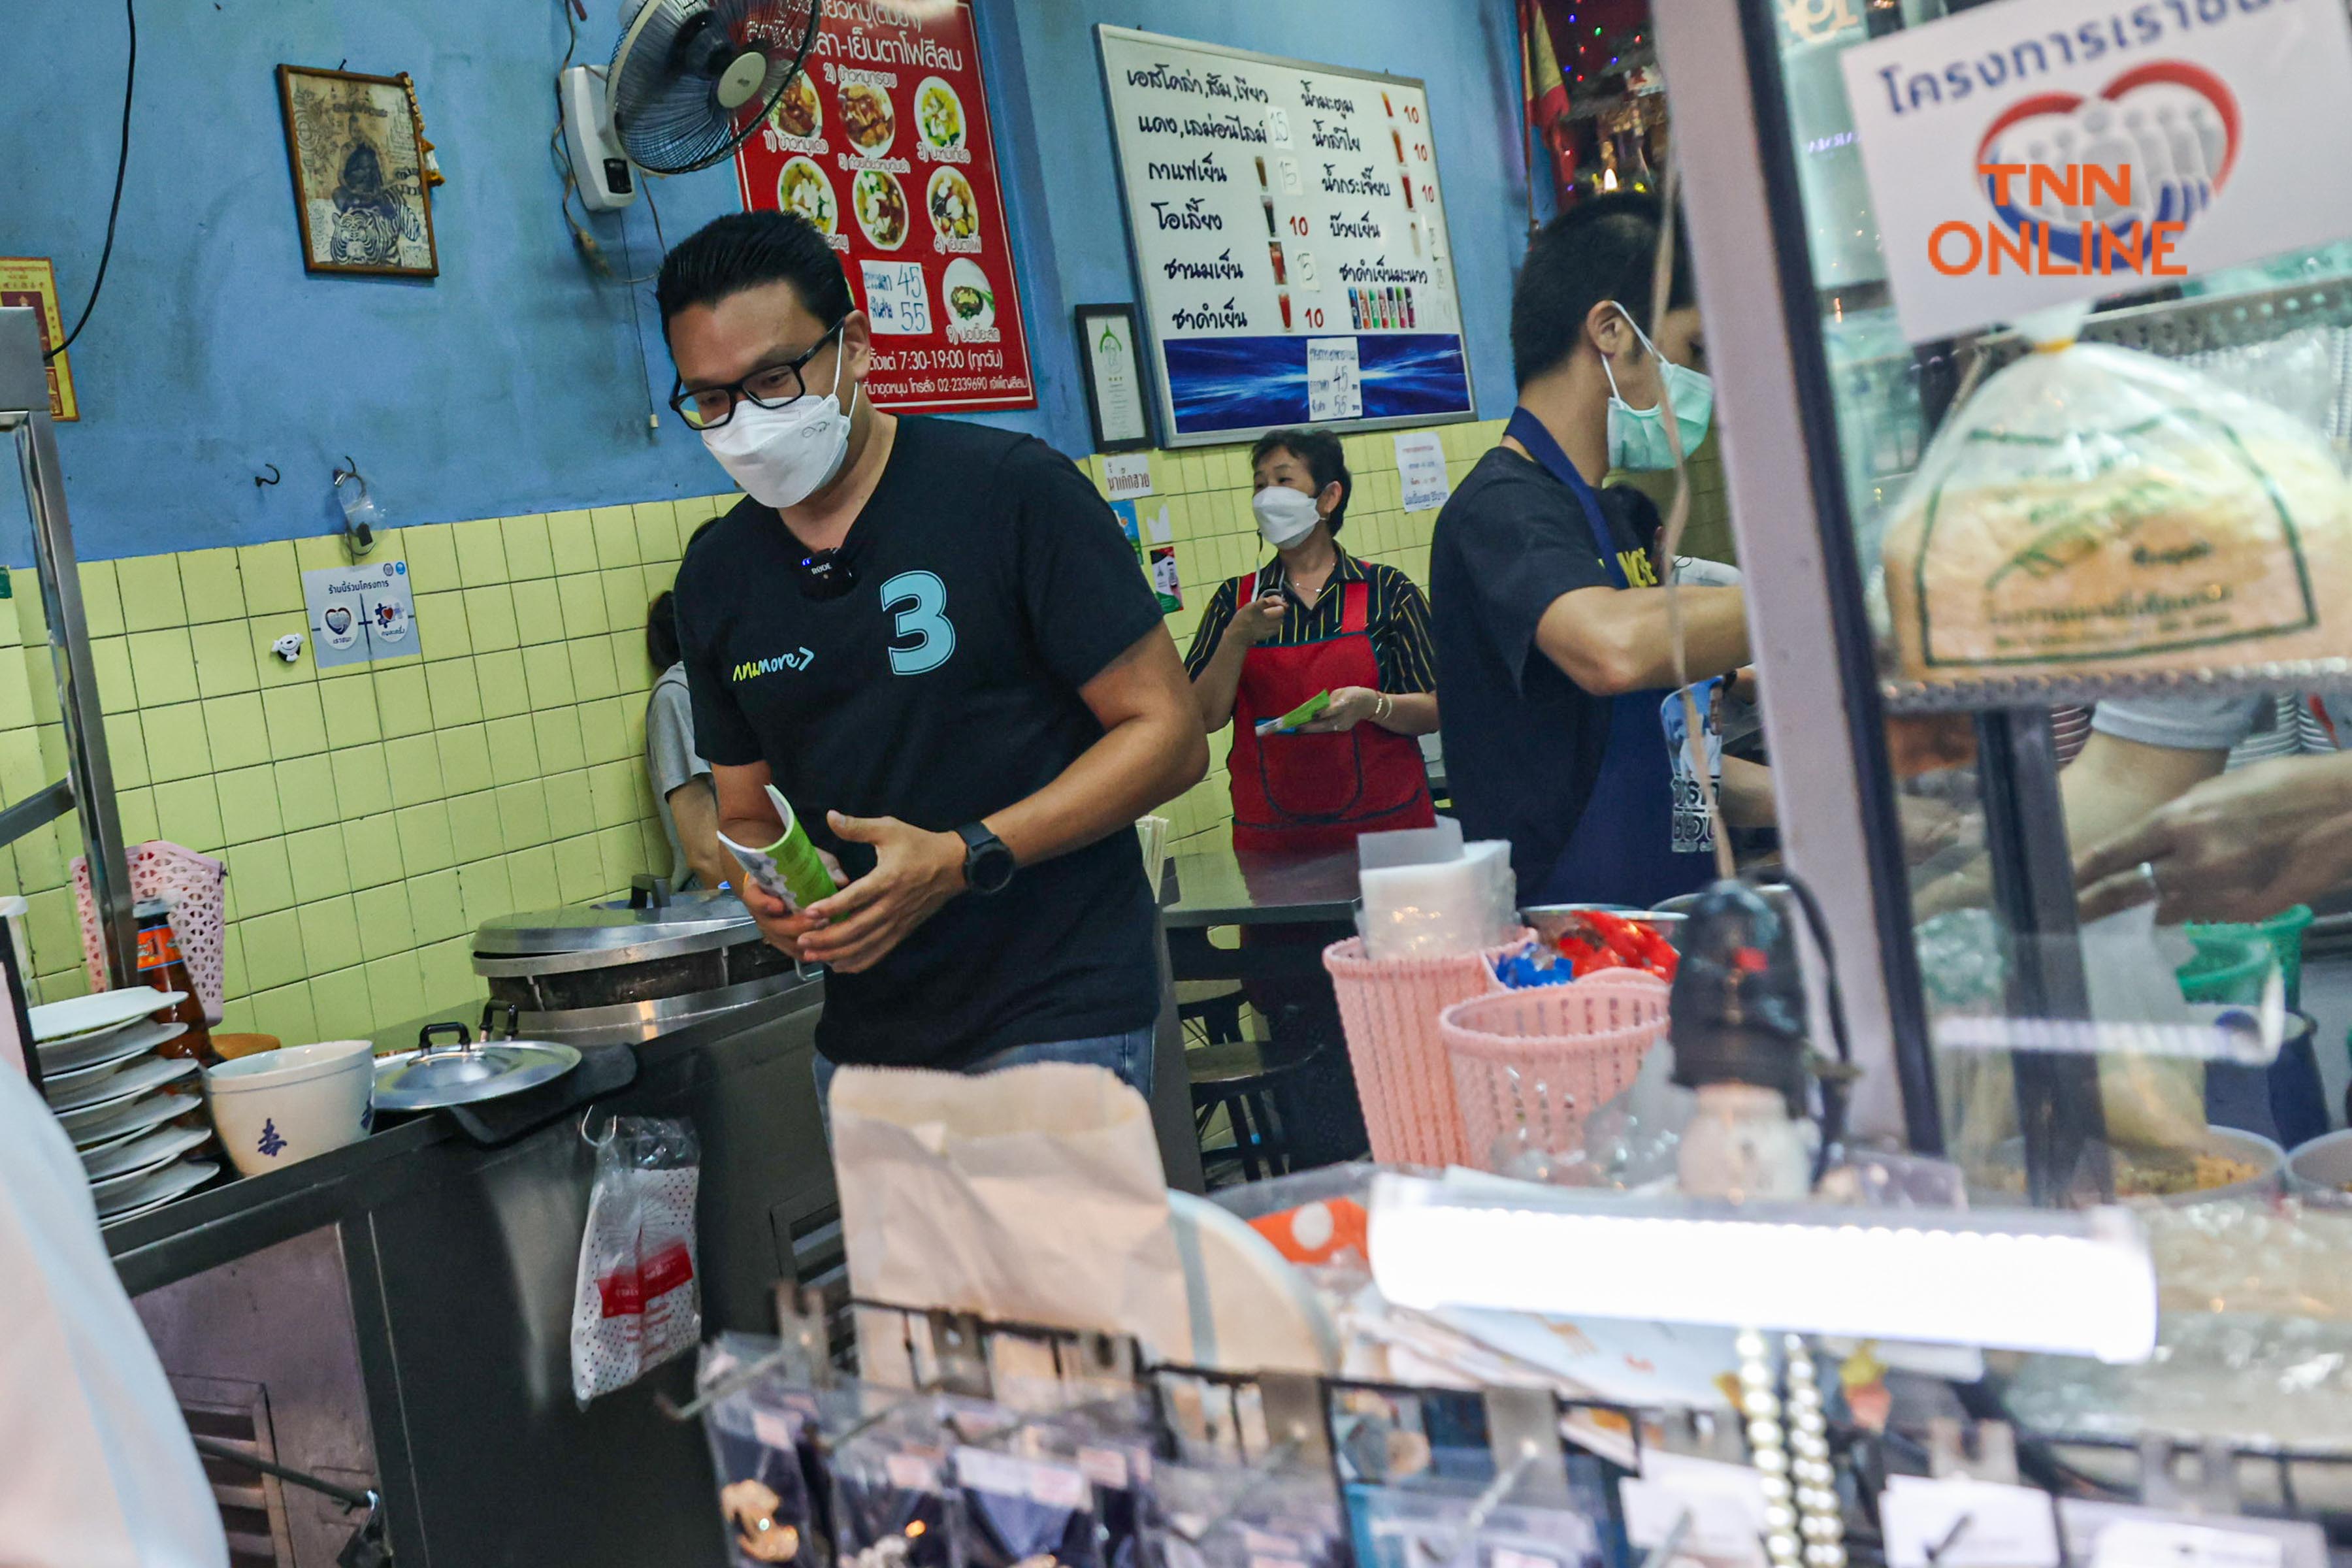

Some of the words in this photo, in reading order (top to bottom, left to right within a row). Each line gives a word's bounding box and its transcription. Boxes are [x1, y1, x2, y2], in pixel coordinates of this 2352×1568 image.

[1404, 105, 1420, 124] 10
[1414, 143, 1428, 162] 10
[1422, 184, 1435, 203] 10
[1289, 216, 1309, 237] 10
[897, 264, 921, 298] 45
[901, 302, 926, 332] 55
[1305, 308, 1324, 328] 10
[898, 349, 964, 370] 7:30-19:00
[938, 376, 987, 392] 02-2339690
[879, 570, 956, 676] 3
